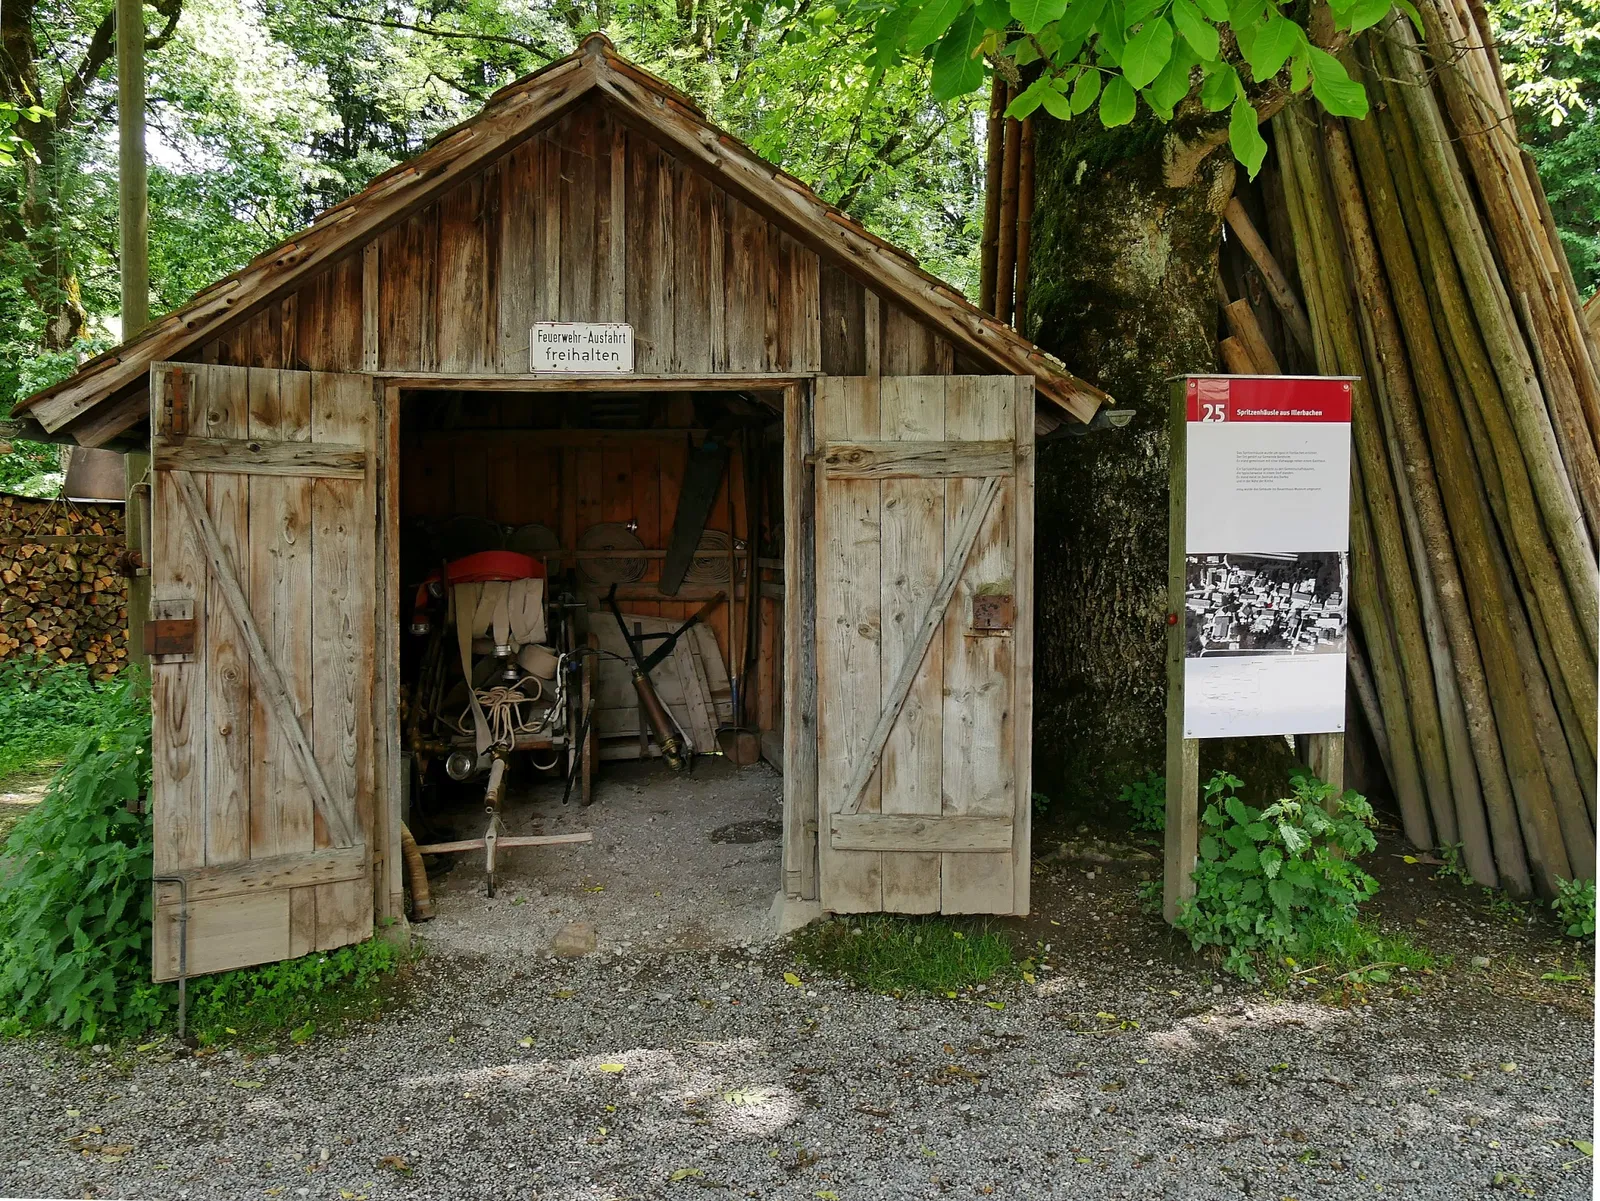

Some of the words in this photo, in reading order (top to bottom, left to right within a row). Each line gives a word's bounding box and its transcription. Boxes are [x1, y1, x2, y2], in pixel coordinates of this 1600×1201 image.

[538, 329, 626, 344] Feuerwehr-Ausfahrt
[546, 347, 619, 361] freihalten
[1202, 404, 1226, 423] 25
[1236, 408, 1279, 417] Spritzenhäusle
